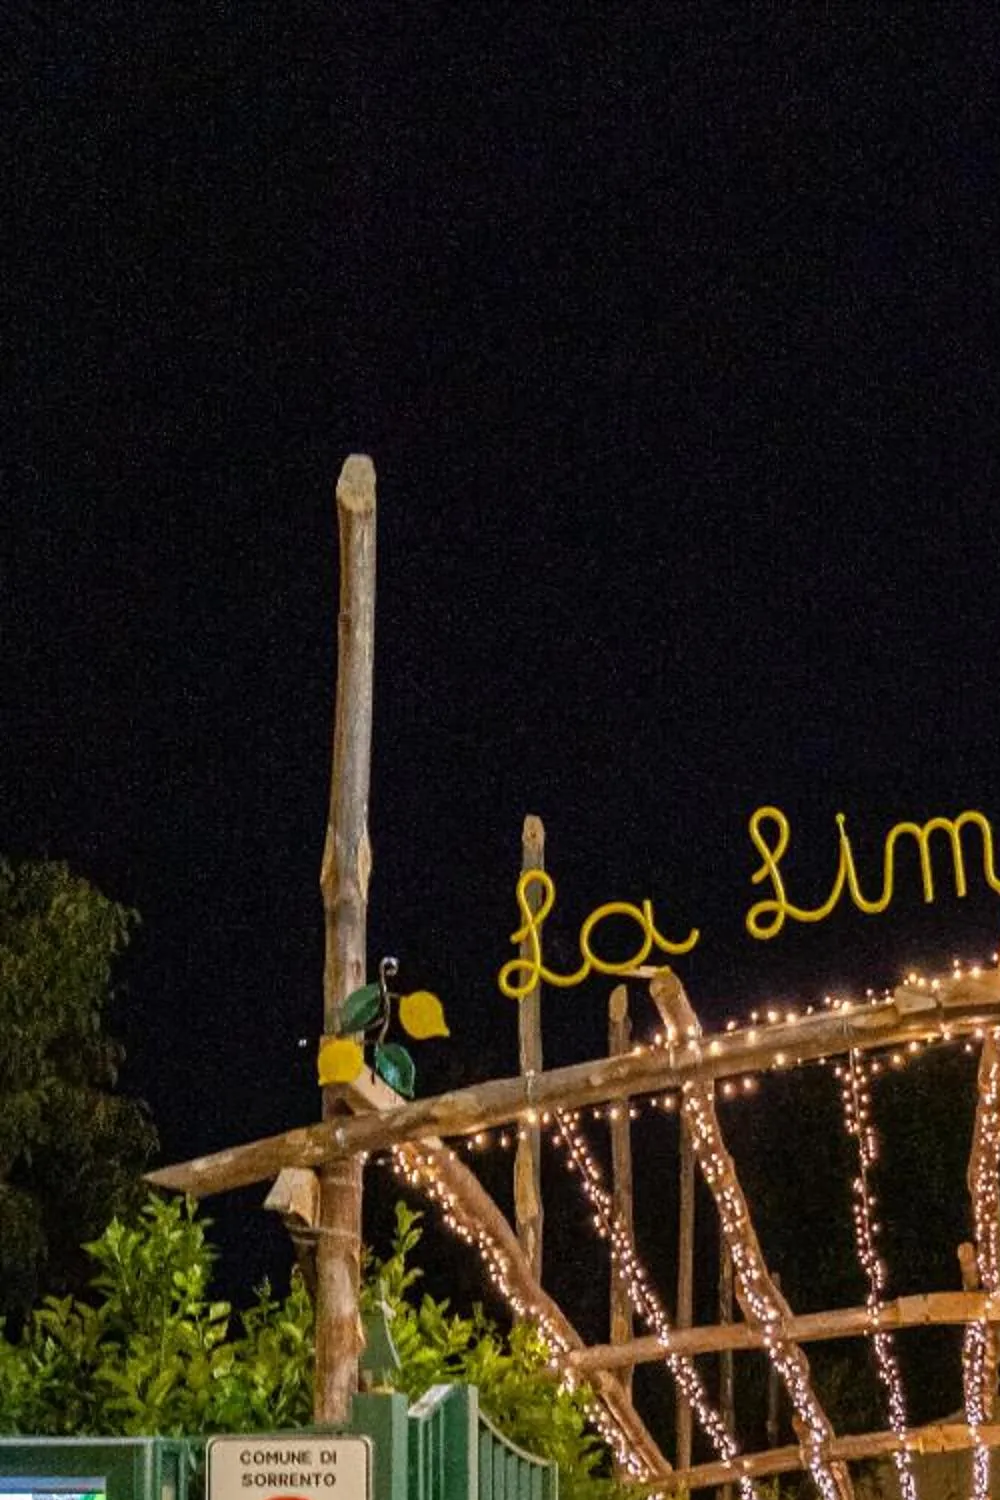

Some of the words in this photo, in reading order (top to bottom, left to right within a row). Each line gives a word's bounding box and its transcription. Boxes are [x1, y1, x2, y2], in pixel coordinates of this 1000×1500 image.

[498, 869, 700, 1000] La
[239, 1450, 312, 1465] COMUNE
[319, 1450, 337, 1465] DI
[241, 1472, 336, 1488] SORRENTO
